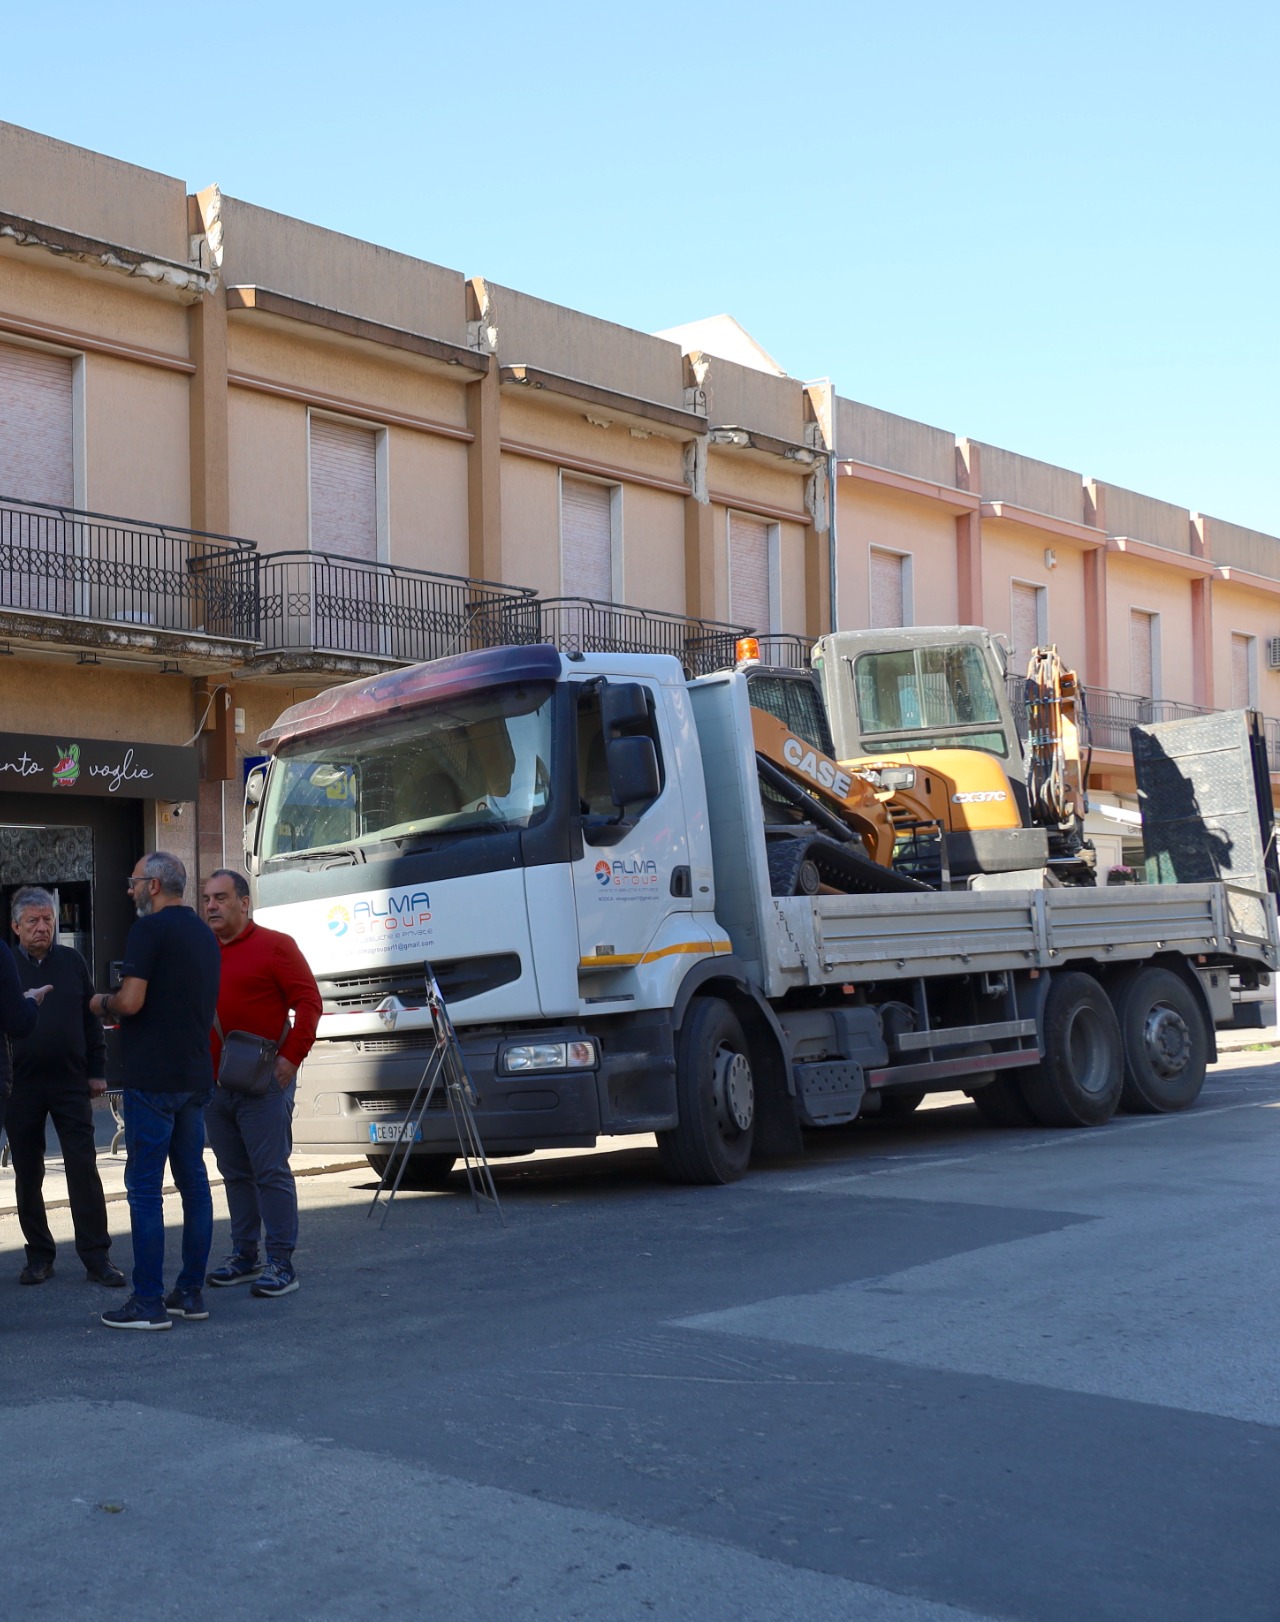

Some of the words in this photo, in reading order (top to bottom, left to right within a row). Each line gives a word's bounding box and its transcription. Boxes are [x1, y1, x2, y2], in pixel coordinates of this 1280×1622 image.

[89, 748, 154, 792] voglie
[783, 738, 852, 800] CASE
[952, 791, 1007, 804] CX37C
[612, 860, 657, 874] ALMA
[354, 892, 431, 919] ALMA
